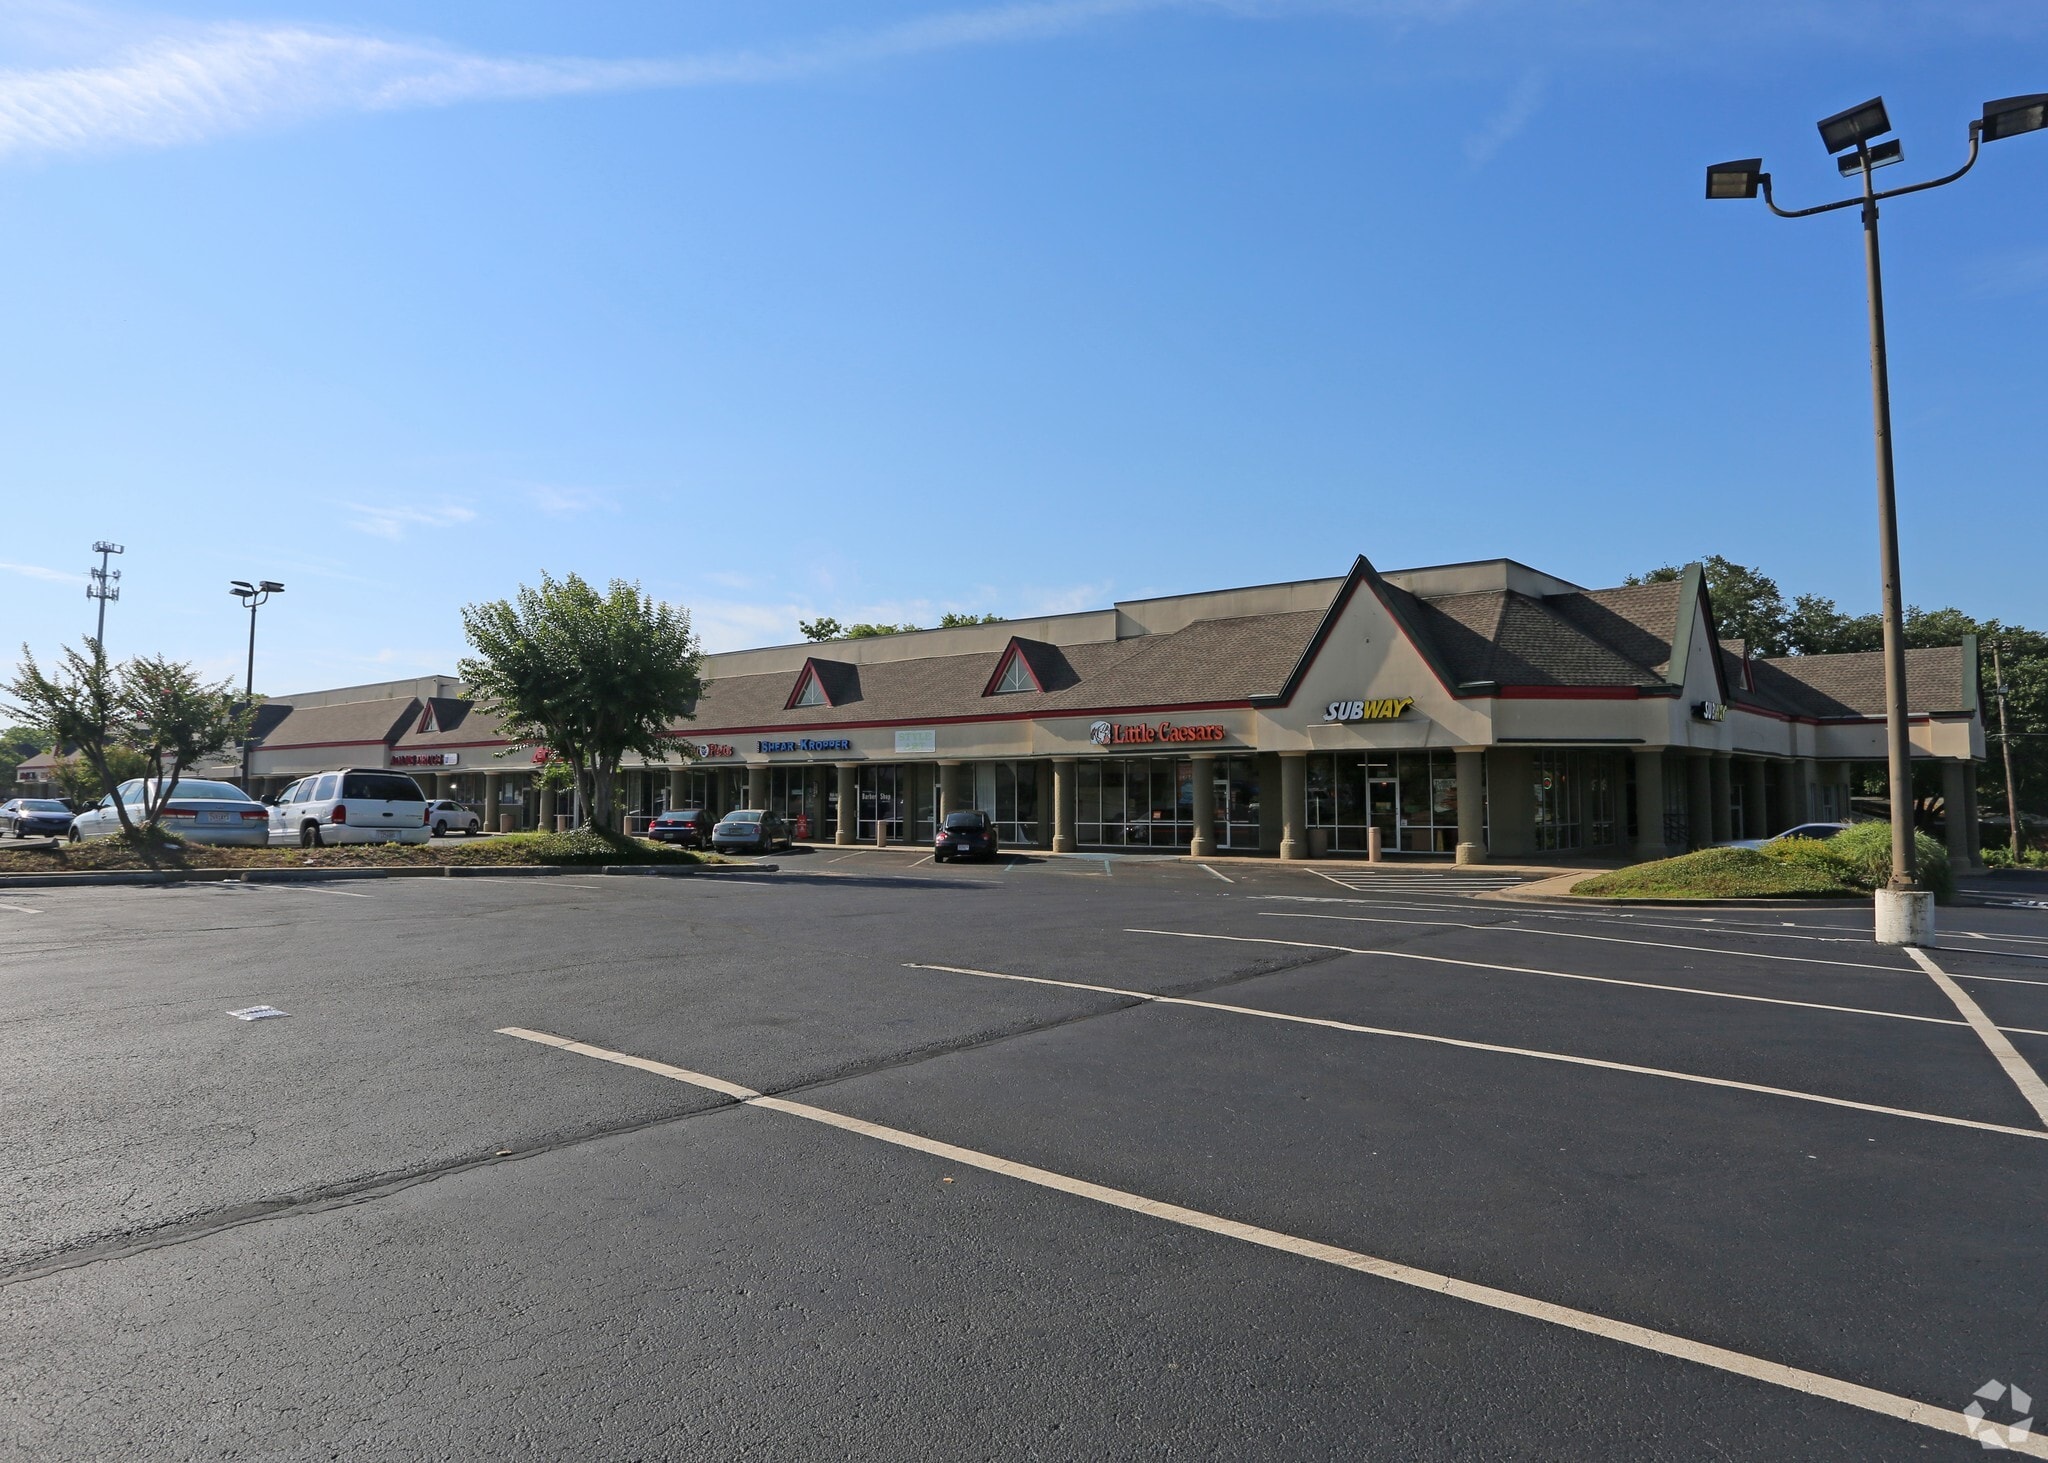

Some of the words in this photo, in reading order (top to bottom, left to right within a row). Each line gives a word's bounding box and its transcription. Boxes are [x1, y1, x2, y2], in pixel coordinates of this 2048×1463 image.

[1323, 697, 1414, 720] SUBWAY
[1112, 723, 1155, 744] Little
[1158, 721, 1225, 741] Caesars
[761, 741, 795, 752] SHEAR
[800, 739, 850, 750] KROPPER
